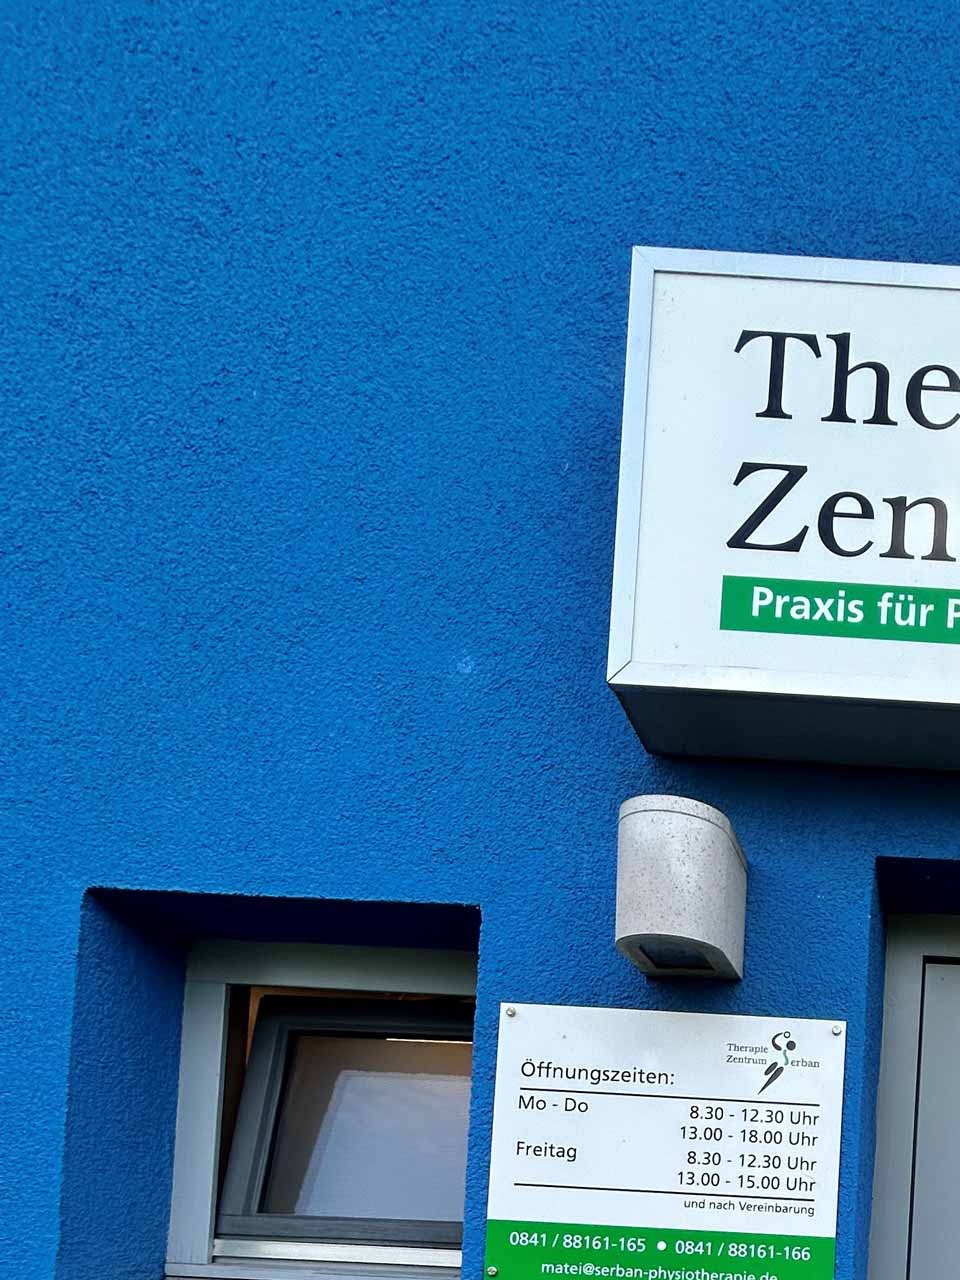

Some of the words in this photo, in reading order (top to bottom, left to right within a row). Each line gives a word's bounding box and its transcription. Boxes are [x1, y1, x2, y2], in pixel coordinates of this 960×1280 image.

[751, 585, 864, 624] Praxis
[876, 591, 934, 629] für
[726, 1043, 769, 1054] Therapie
[726, 1054, 767, 1065] Zentrum
[521, 1058, 675, 1085] Öffnungszeiten:
[518, 1095, 547, 1110] Mo
[564, 1097, 589, 1113] Do
[689, 1105, 724, 1120] 8.30
[741, 1108, 784, 1124] 12.30
[789, 1111, 820, 1126] Uhr
[680, 1126, 723, 1141] 13.00
[740, 1129, 783, 1144] 18.00
[788, 1131, 819, 1146] Uhr
[516, 1141, 577, 1162] Freitag
[687, 1151, 721, 1166] 8.30
[739, 1154, 782, 1169] 12.30
[787, 1156, 817, 1171] Uhr
[677, 1171, 720, 1187] 13.00
[737, 1174, 780, 1190] 15.00
[786, 1177, 816, 1192] Uhr
[683, 1199, 706, 1209] und
[709, 1200, 735, 1211] nach
[739, 1201, 815, 1217] Vereinbarung
[509, 1231, 547, 1247] 0841
[552, 1233, 559, 1248] /
[562, 1234, 646, 1252] 88161-165
[675, 1240, 712, 1256] 0841
[717, 1242, 725, 1257] /
[728, 1243, 811, 1261] 88161-166
